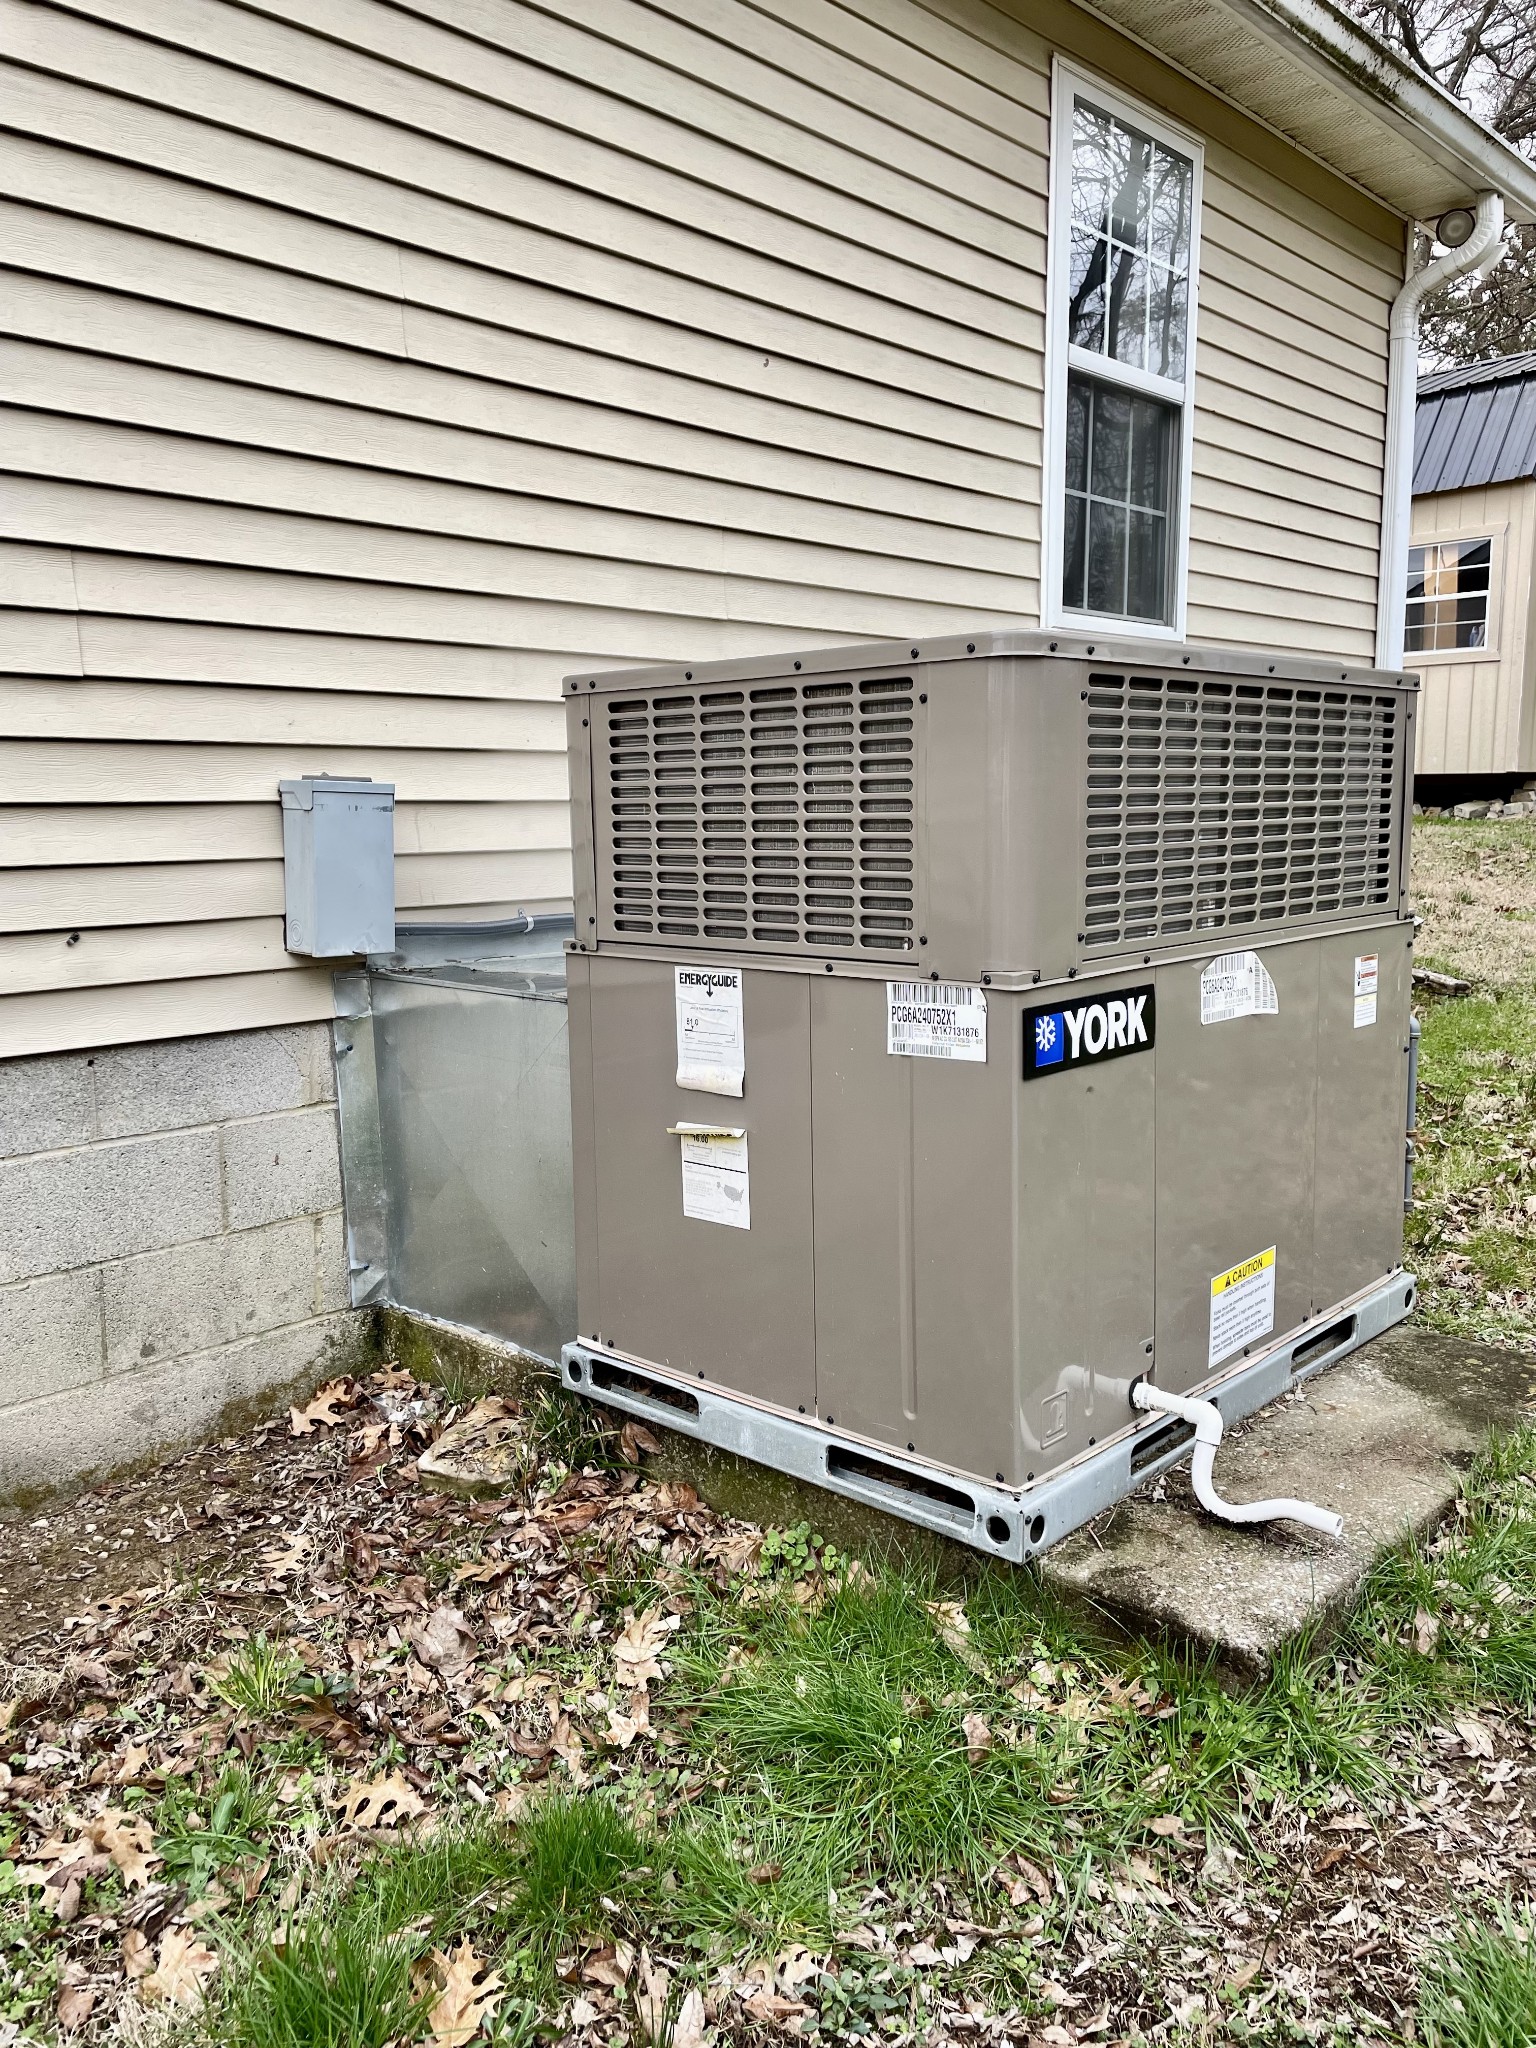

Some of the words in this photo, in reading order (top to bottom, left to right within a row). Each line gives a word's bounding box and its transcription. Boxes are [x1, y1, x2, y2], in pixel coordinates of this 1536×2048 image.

[679, 972, 738, 990] ENERGYGUIDE
[891, 1006, 956, 1026] PCG6A240752X1
[931, 1025, 979, 1038] W1K7131876
[1063, 995, 1148, 1059] YORK
[1232, 1257, 1263, 1283] CAUTION
